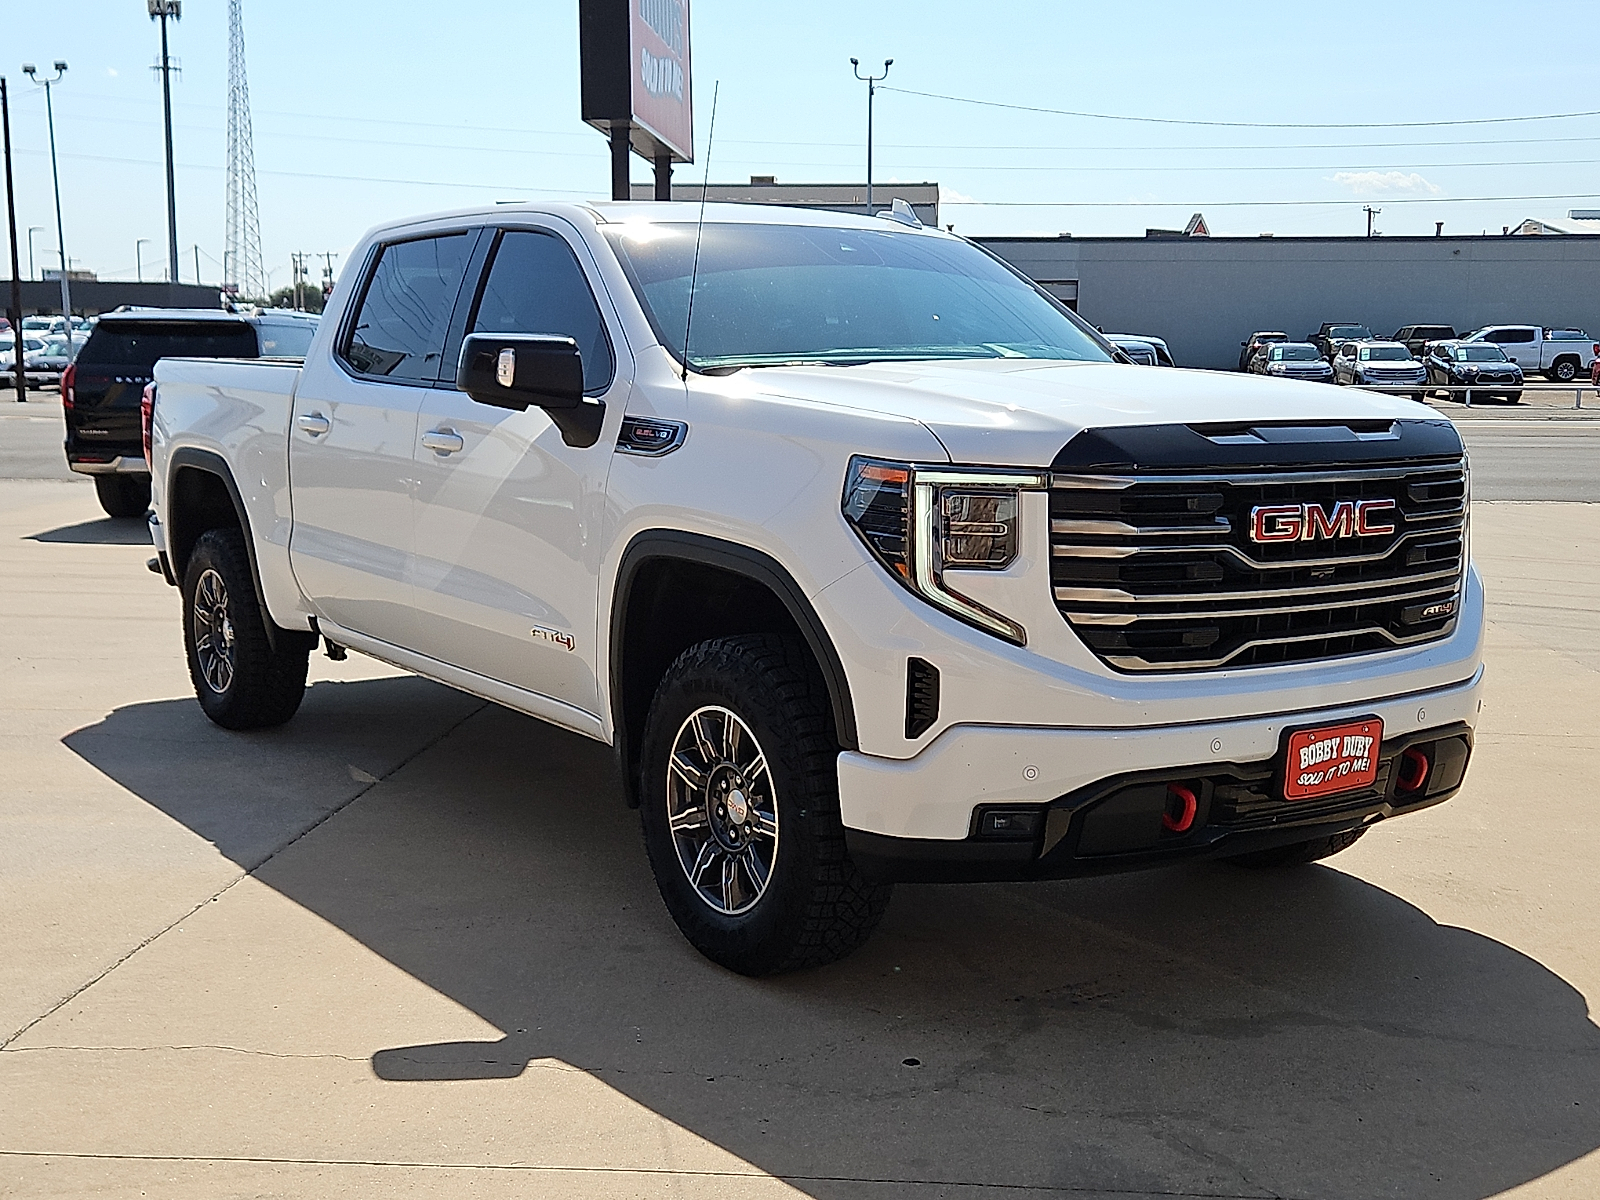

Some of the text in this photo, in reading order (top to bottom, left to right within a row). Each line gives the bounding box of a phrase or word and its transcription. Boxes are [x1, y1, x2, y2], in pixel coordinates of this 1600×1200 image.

[1250, 499, 1395, 543] GMC
[1422, 602, 1453, 616] AT4
[531, 624, 576, 652] AT4
[1299, 735, 1374, 770] BOBBY DUBY
[1297, 758, 1371, 786] SOLD IT TO ME!
